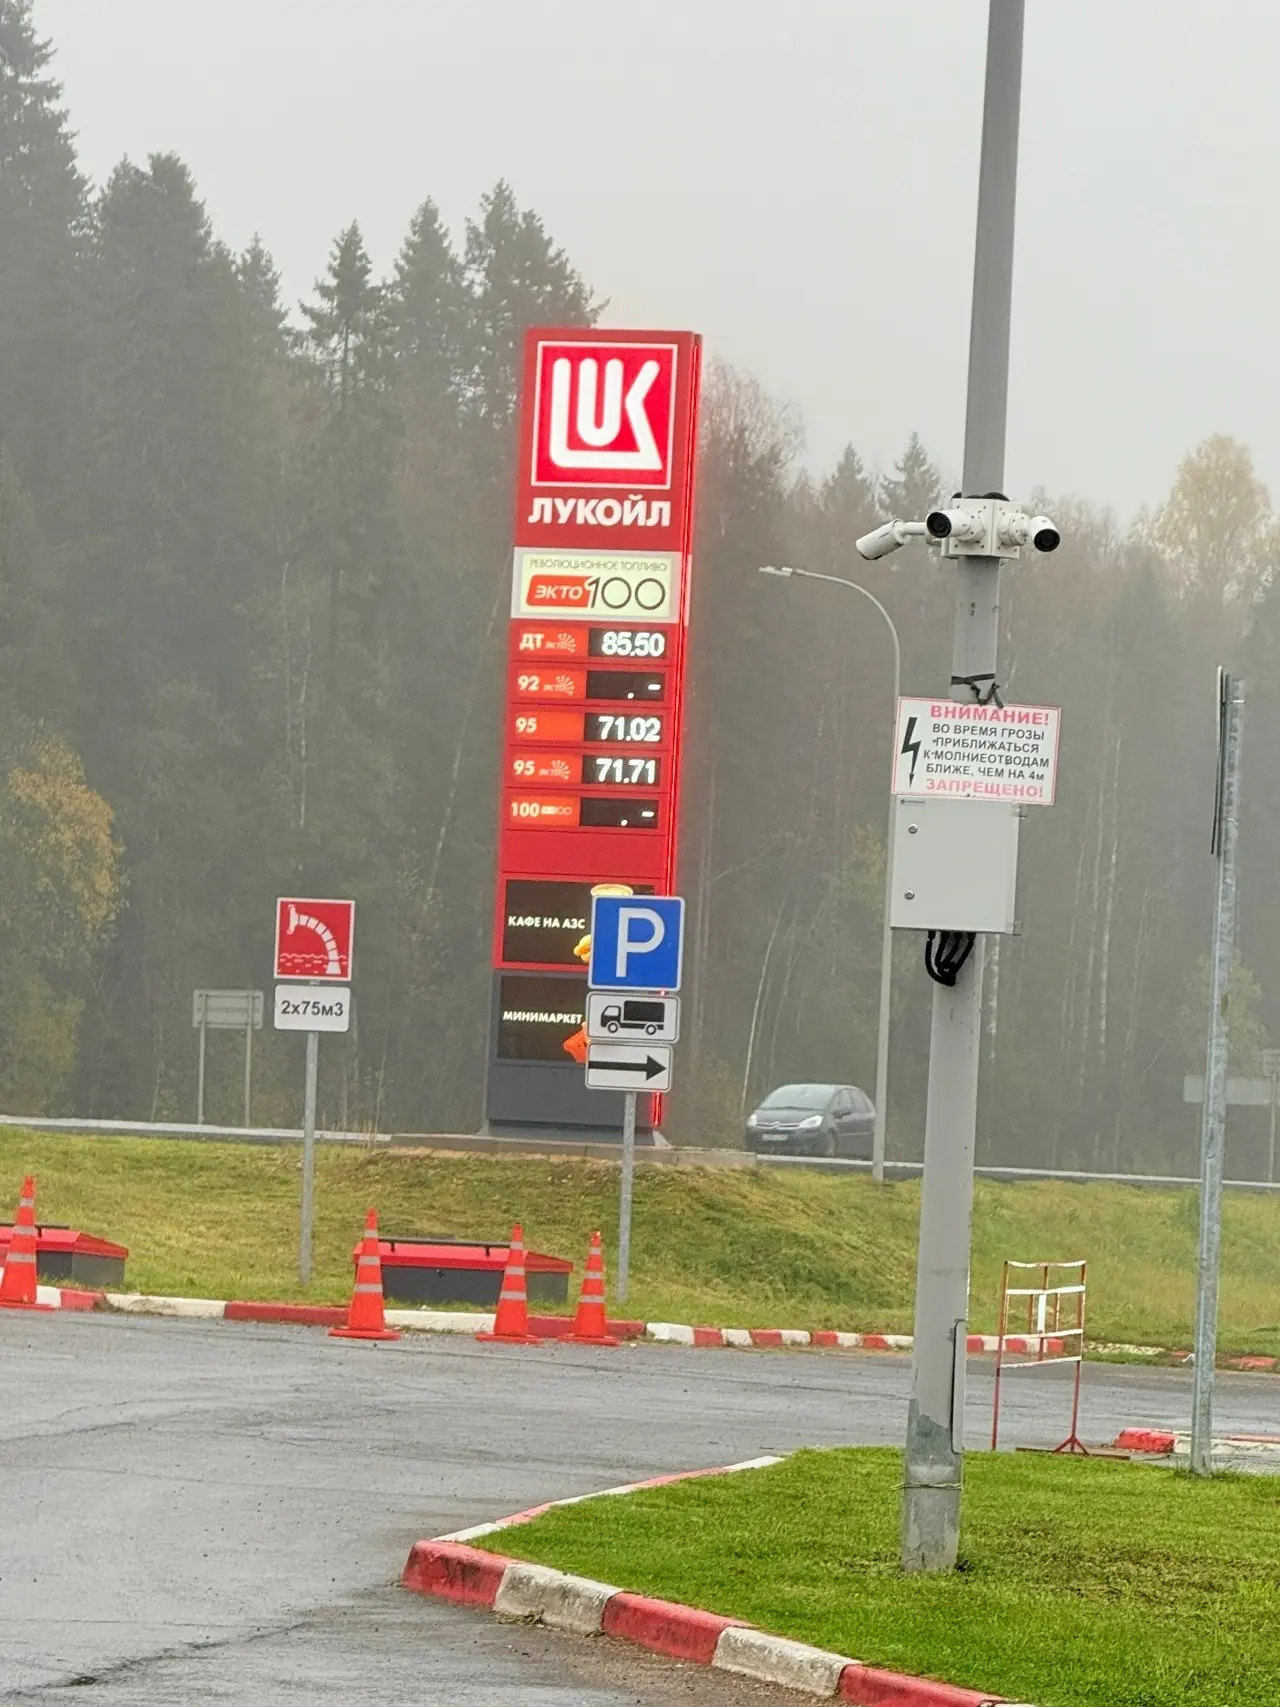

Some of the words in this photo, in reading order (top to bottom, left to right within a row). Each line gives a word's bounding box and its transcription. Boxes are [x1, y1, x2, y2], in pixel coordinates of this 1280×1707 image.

[528, 494, 671, 527] ЛУКОЙЛ
[529, 558, 620, 571] РЕВОЛЮЦИОННОЕ
[621, 561, 667, 572] ТОПЛИВО
[519, 633, 544, 651] ДТ
[601, 631, 666, 658] 85.50
[518, 675, 540, 691] 92
[930, 704, 1049, 726] ВНИМАНИЕ!
[515, 717, 537, 733] 95
[599, 715, 661, 742] 71.02
[932, 723, 950, 734] ВО
[954, 724, 997, 737] ВРЕМЯ
[1001, 728, 1045, 740] ГРОЗЫ
[935, 737, 1039, 753] ПРИБЛИЖАТЬСЯ
[934, 750, 1049, 767] МОЛНИЕОТВОДАМ
[513, 760, 535, 776] 95
[596, 757, 656, 784] 71.71
[926, 763, 974, 776] БЛИЖЕ,
[978, 767, 1004, 777] ЧЕМ
[1008, 770, 1025, 780] НА
[926, 778, 1044, 797] ЗАПРЕЩЕНО!
[511, 802, 540, 817] 100
[508, 916, 541, 928] КАФЕ
[543, 917, 560, 928] НА
[562, 918, 586, 930] АЗС
[615, 907, 665, 978] P
[502, 1010, 583, 1024] МИНИМАРКЕТ
